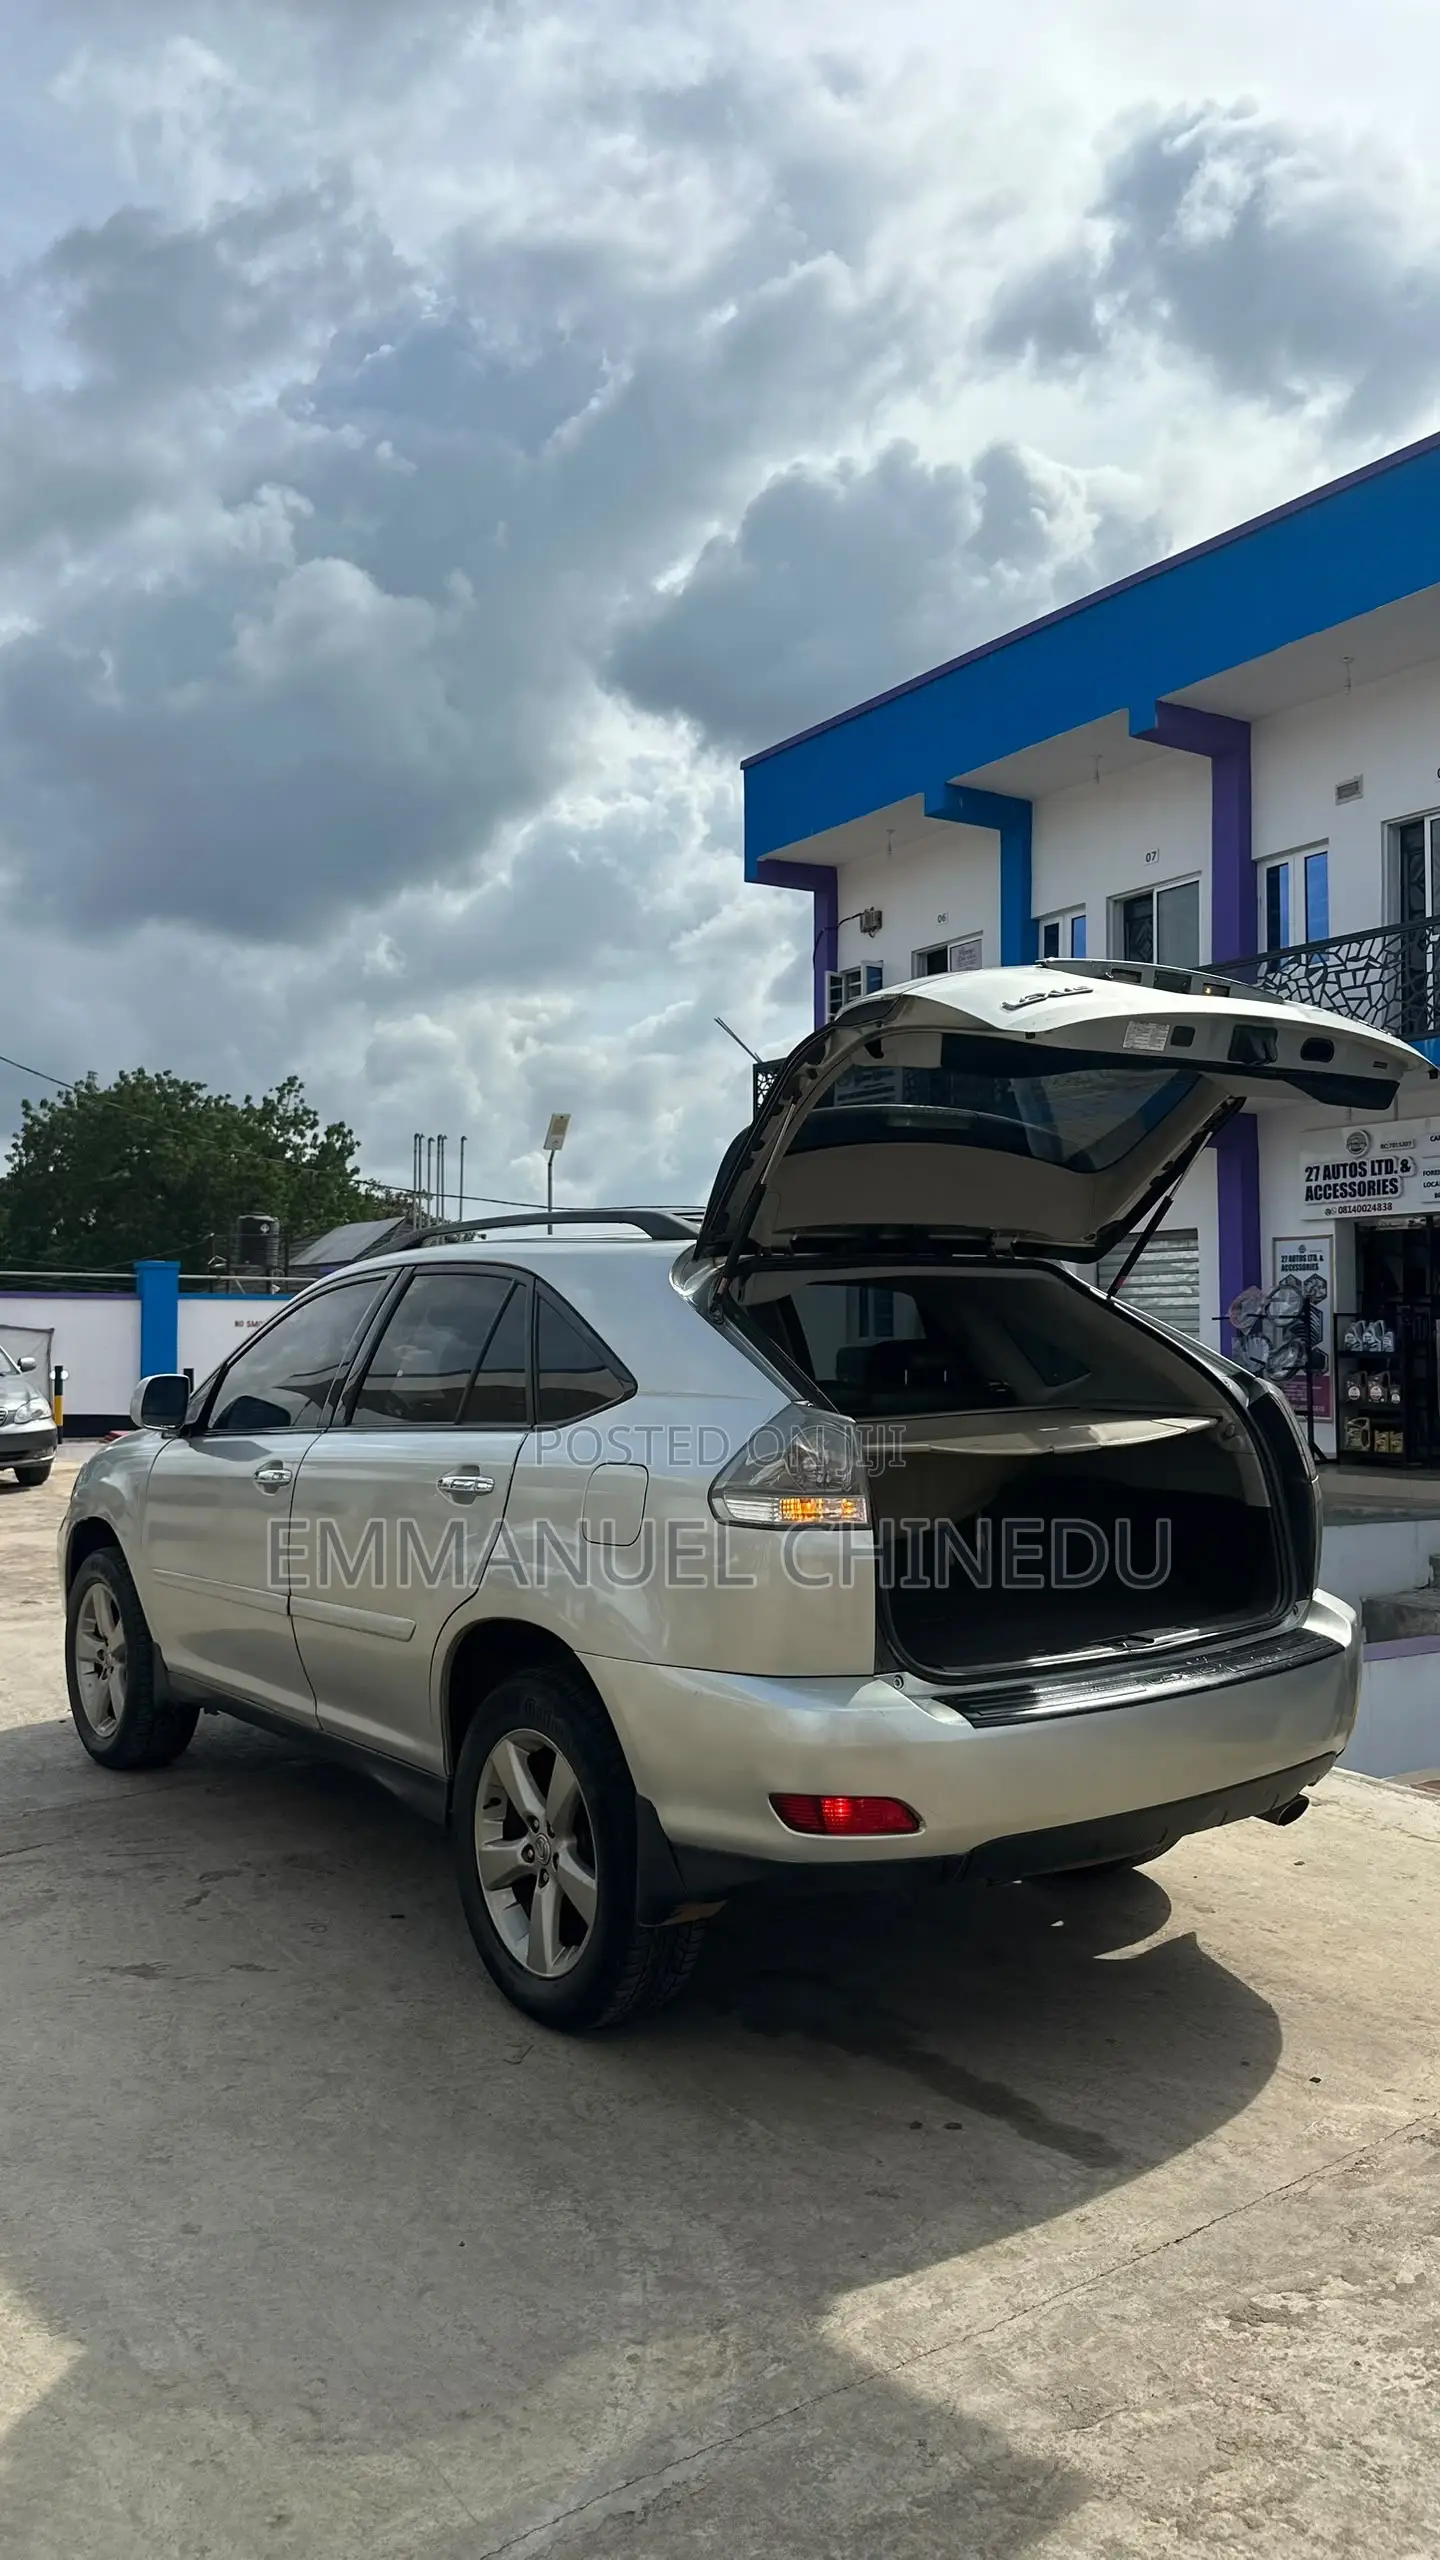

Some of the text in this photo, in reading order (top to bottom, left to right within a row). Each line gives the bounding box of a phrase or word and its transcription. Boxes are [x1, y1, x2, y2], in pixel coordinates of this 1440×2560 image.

[1145, 851, 1157, 863] 07
[1304, 1158, 1411, 1182] 27 AUTOS LTD. &
[1304, 1177, 1399, 1201] ACCESSORIES
[1337, 1202, 1393, 1215] 08140024838
